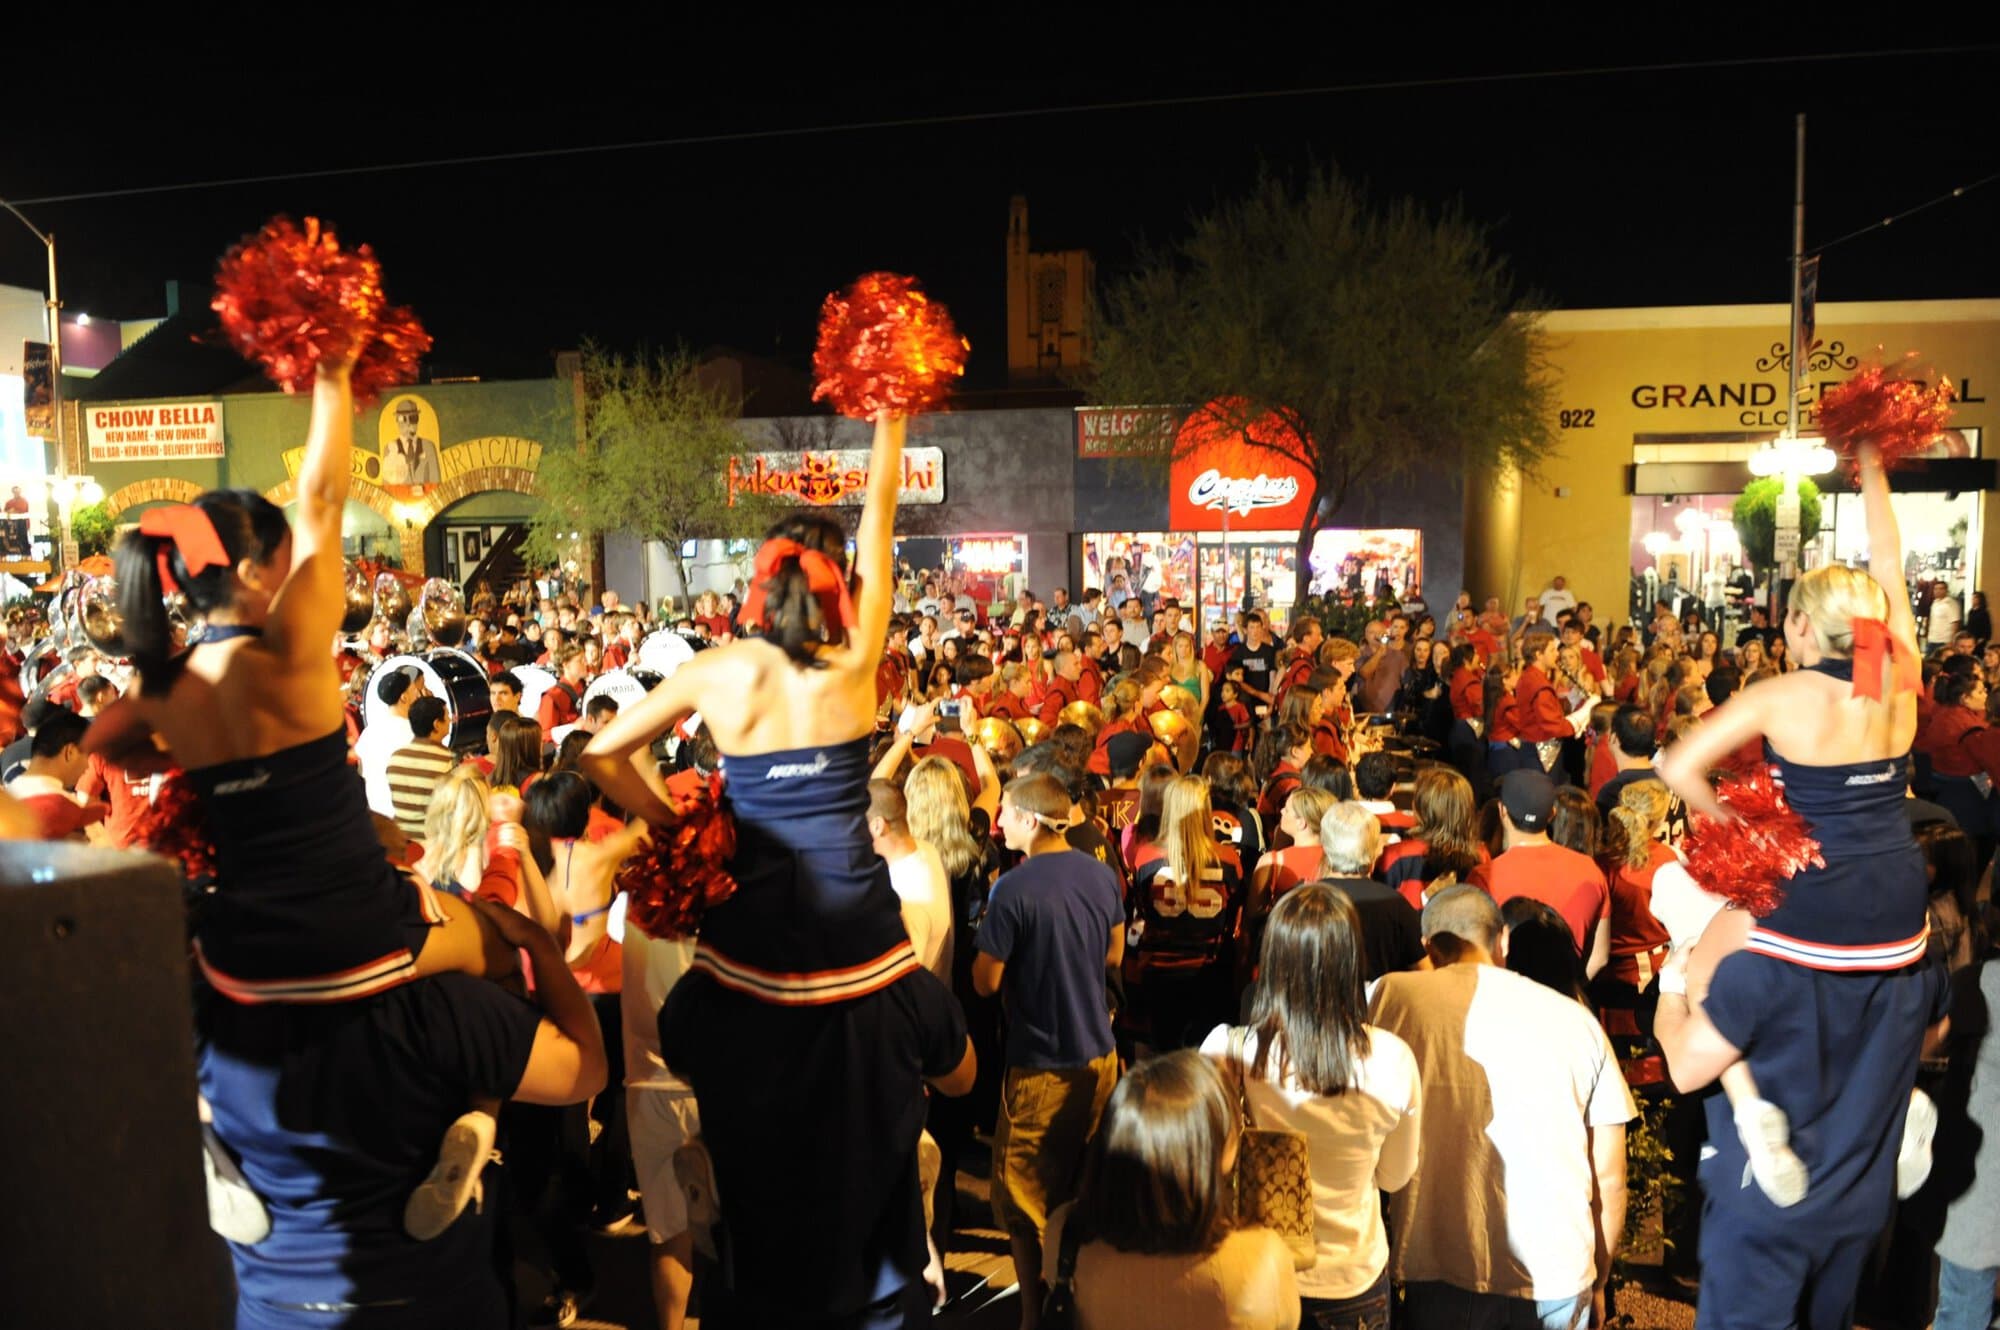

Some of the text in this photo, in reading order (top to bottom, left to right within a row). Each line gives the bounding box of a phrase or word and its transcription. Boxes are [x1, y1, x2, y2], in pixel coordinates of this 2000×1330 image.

[1631, 382, 1777, 410] GRAND
[95, 407, 215, 429] CHOW BELLA
[1560, 409, 1595, 429] 922
[106, 427, 207, 443] NEW NAME NEW OWNER
[92, 447, 105, 458] FULL
[125, 445, 139, 457] NEW
[140, 445, 159, 457] MENU
[163, 443, 193, 456] DELIVERY
[195, 441, 223, 455] SERVICE
[843, 456, 935, 492] shi
